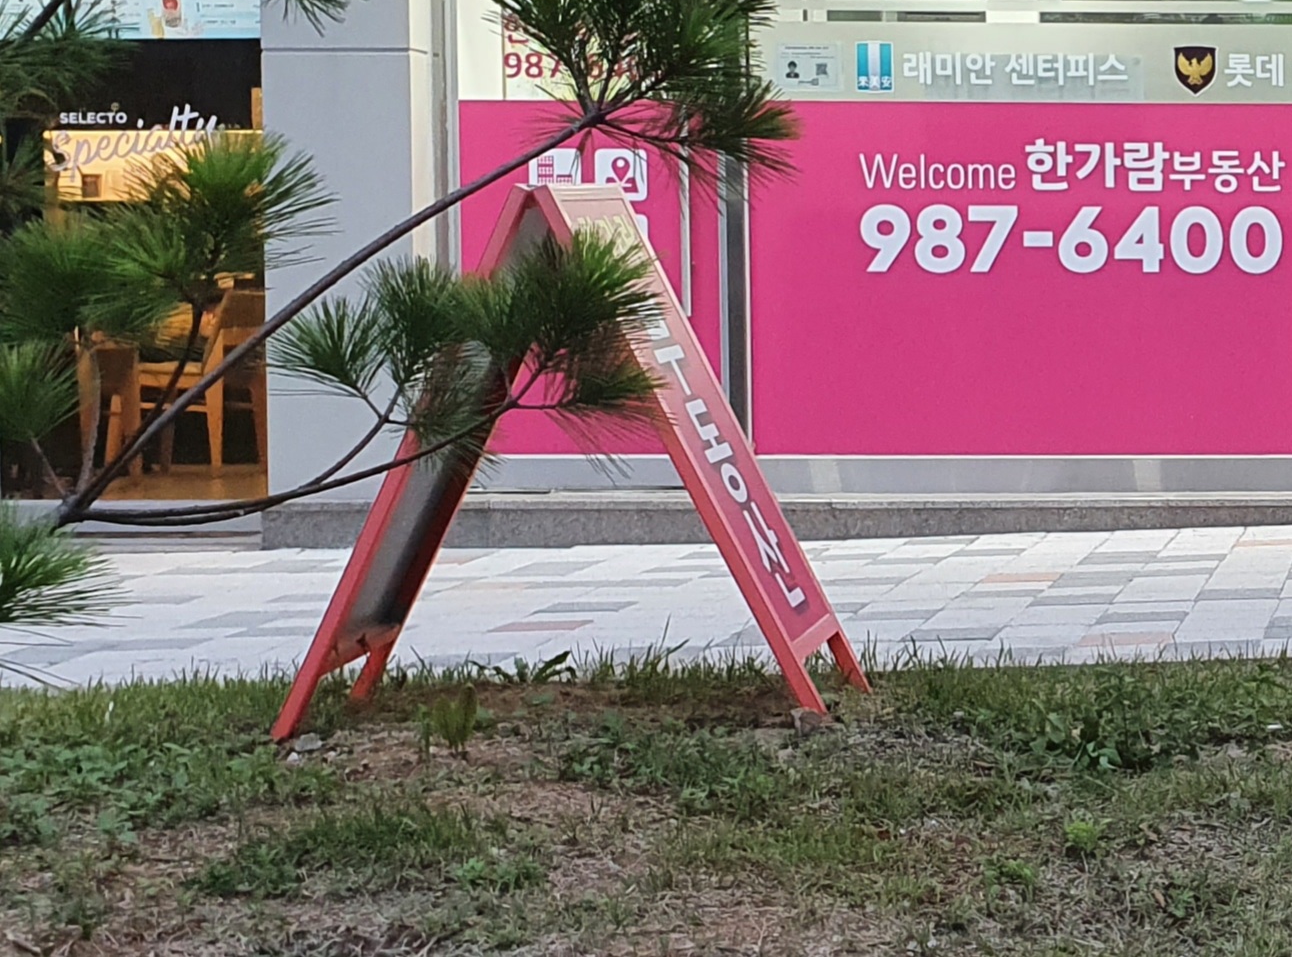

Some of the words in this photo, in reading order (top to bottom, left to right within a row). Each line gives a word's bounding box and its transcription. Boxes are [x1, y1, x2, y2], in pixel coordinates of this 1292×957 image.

[902, 51, 996, 86] 래미안
[1004, 52, 1129, 86] 센터피스
[1224, 53, 1286, 87] 롯데
[59, 111, 128, 125] SELECTO
[859, 153, 1016, 191] Welcome
[859, 204, 1284, 275] 987-6400
